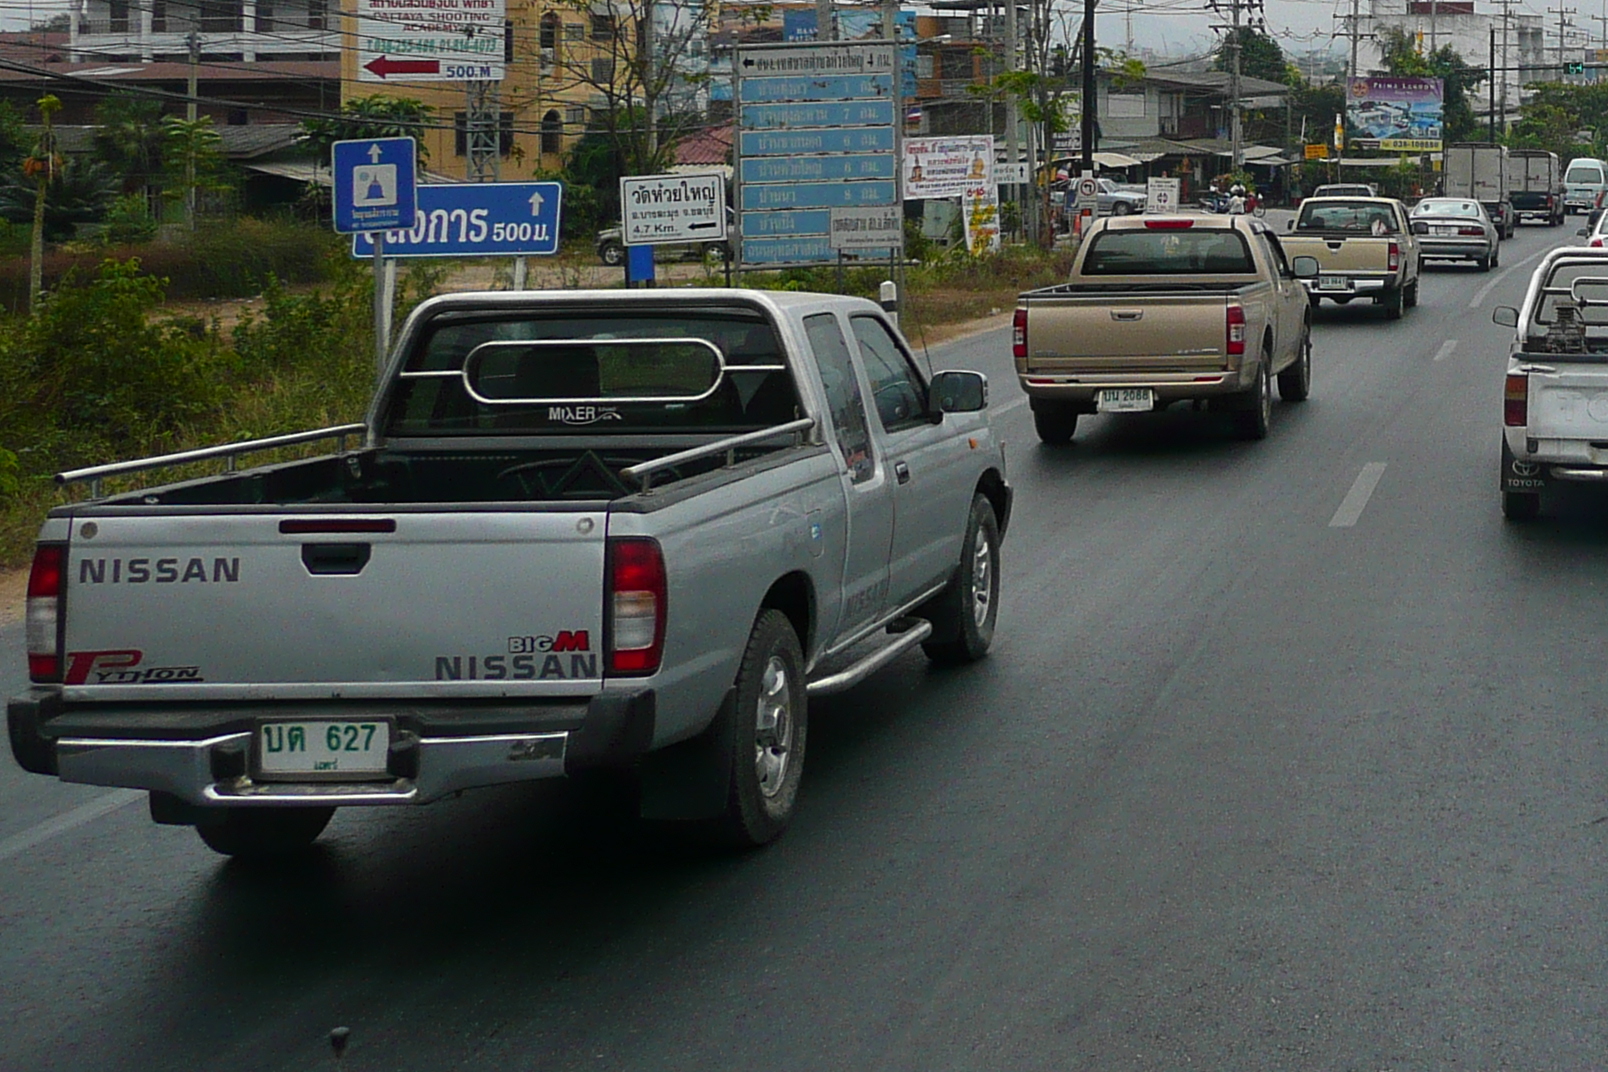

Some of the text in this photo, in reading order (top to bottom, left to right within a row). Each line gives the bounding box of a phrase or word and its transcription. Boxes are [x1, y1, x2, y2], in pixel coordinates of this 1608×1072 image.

[373, 12, 490, 21] PATTAYA SHOOTING
[867, 52, 874, 67] 4
[843, 108, 850, 120] 7
[632, 181, 716, 204] วัดห้วยใหญ่
[633, 224, 651, 234] 4.7
[1508, 479, 1545, 488] TOYOTA
[79, 557, 240, 584] NISSAN
[64, 649, 204, 685] PYTHON
[436, 654, 597, 680] NISSAN
[326, 724, 376, 751] 627
